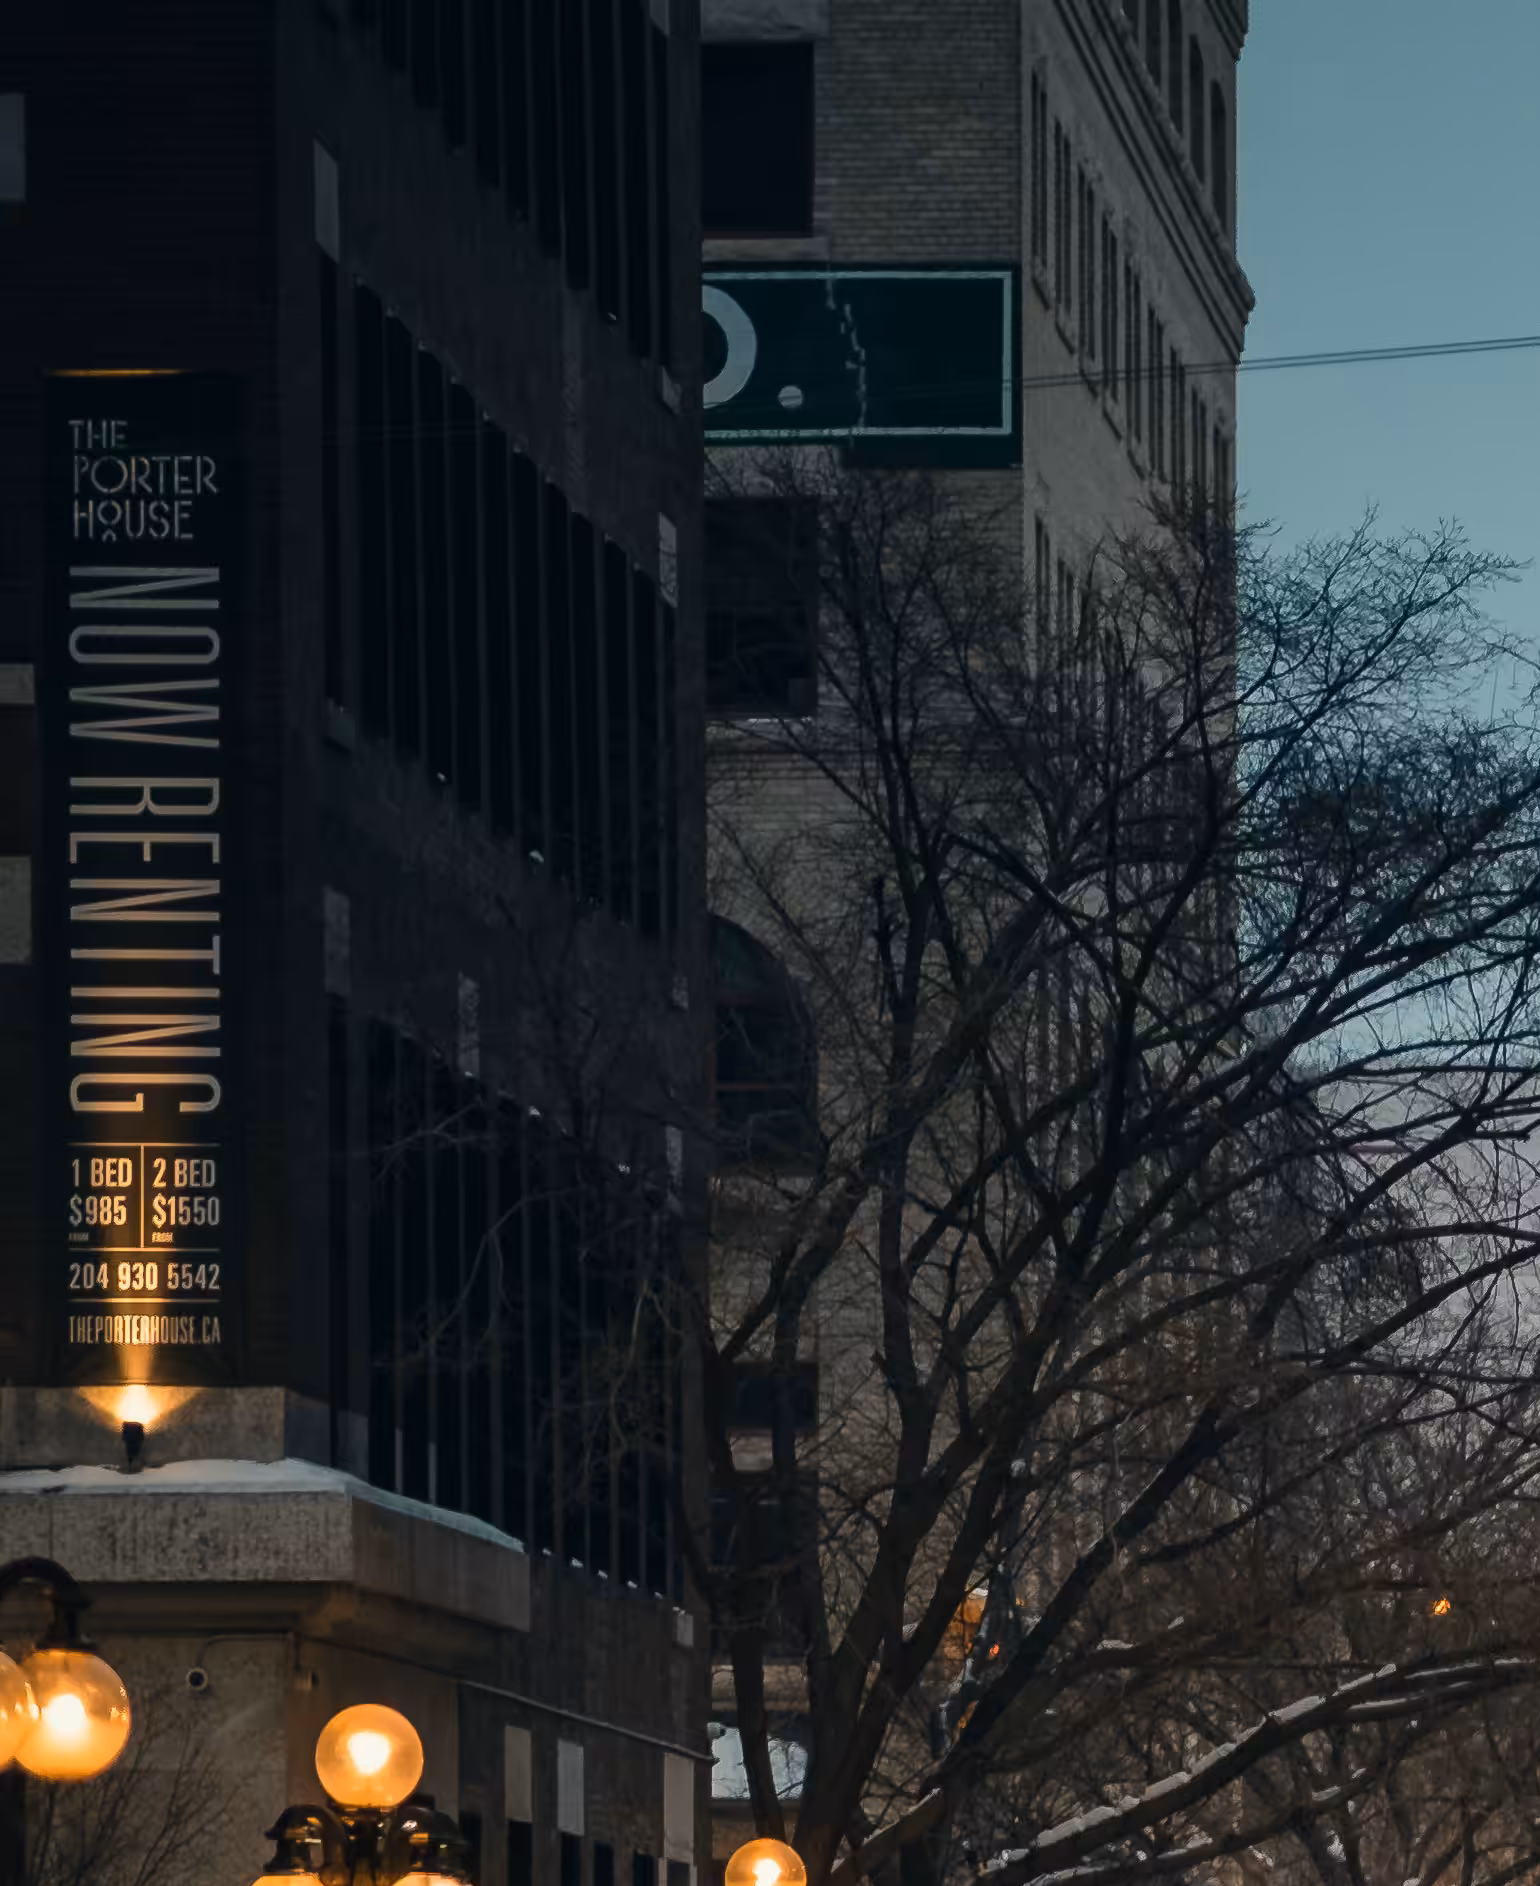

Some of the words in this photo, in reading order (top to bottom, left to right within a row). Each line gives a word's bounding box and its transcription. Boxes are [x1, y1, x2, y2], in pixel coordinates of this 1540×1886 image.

[68, 419, 128, 449] THE
[74, 455, 219, 495] PORTER
[73, 499, 194, 543] HOUSE
[69, 566, 220, 748] NOW
[69, 777, 221, 1112] RENTING
[71, 1158, 80, 1188] 1
[90, 1157, 133, 1188] BED
[152, 1157, 167, 1188] 2
[174, 1158, 216, 1188] BED
[69, 1194, 128, 1226] $985
[152, 1193, 220, 1228] $1550
[69, 1263, 109, 1290] 204
[117, 1262, 159, 1292] 930
[167, 1262, 220, 1290] 5542
[69, 1315, 221, 1345] THEPORTERHOUSE.CA
